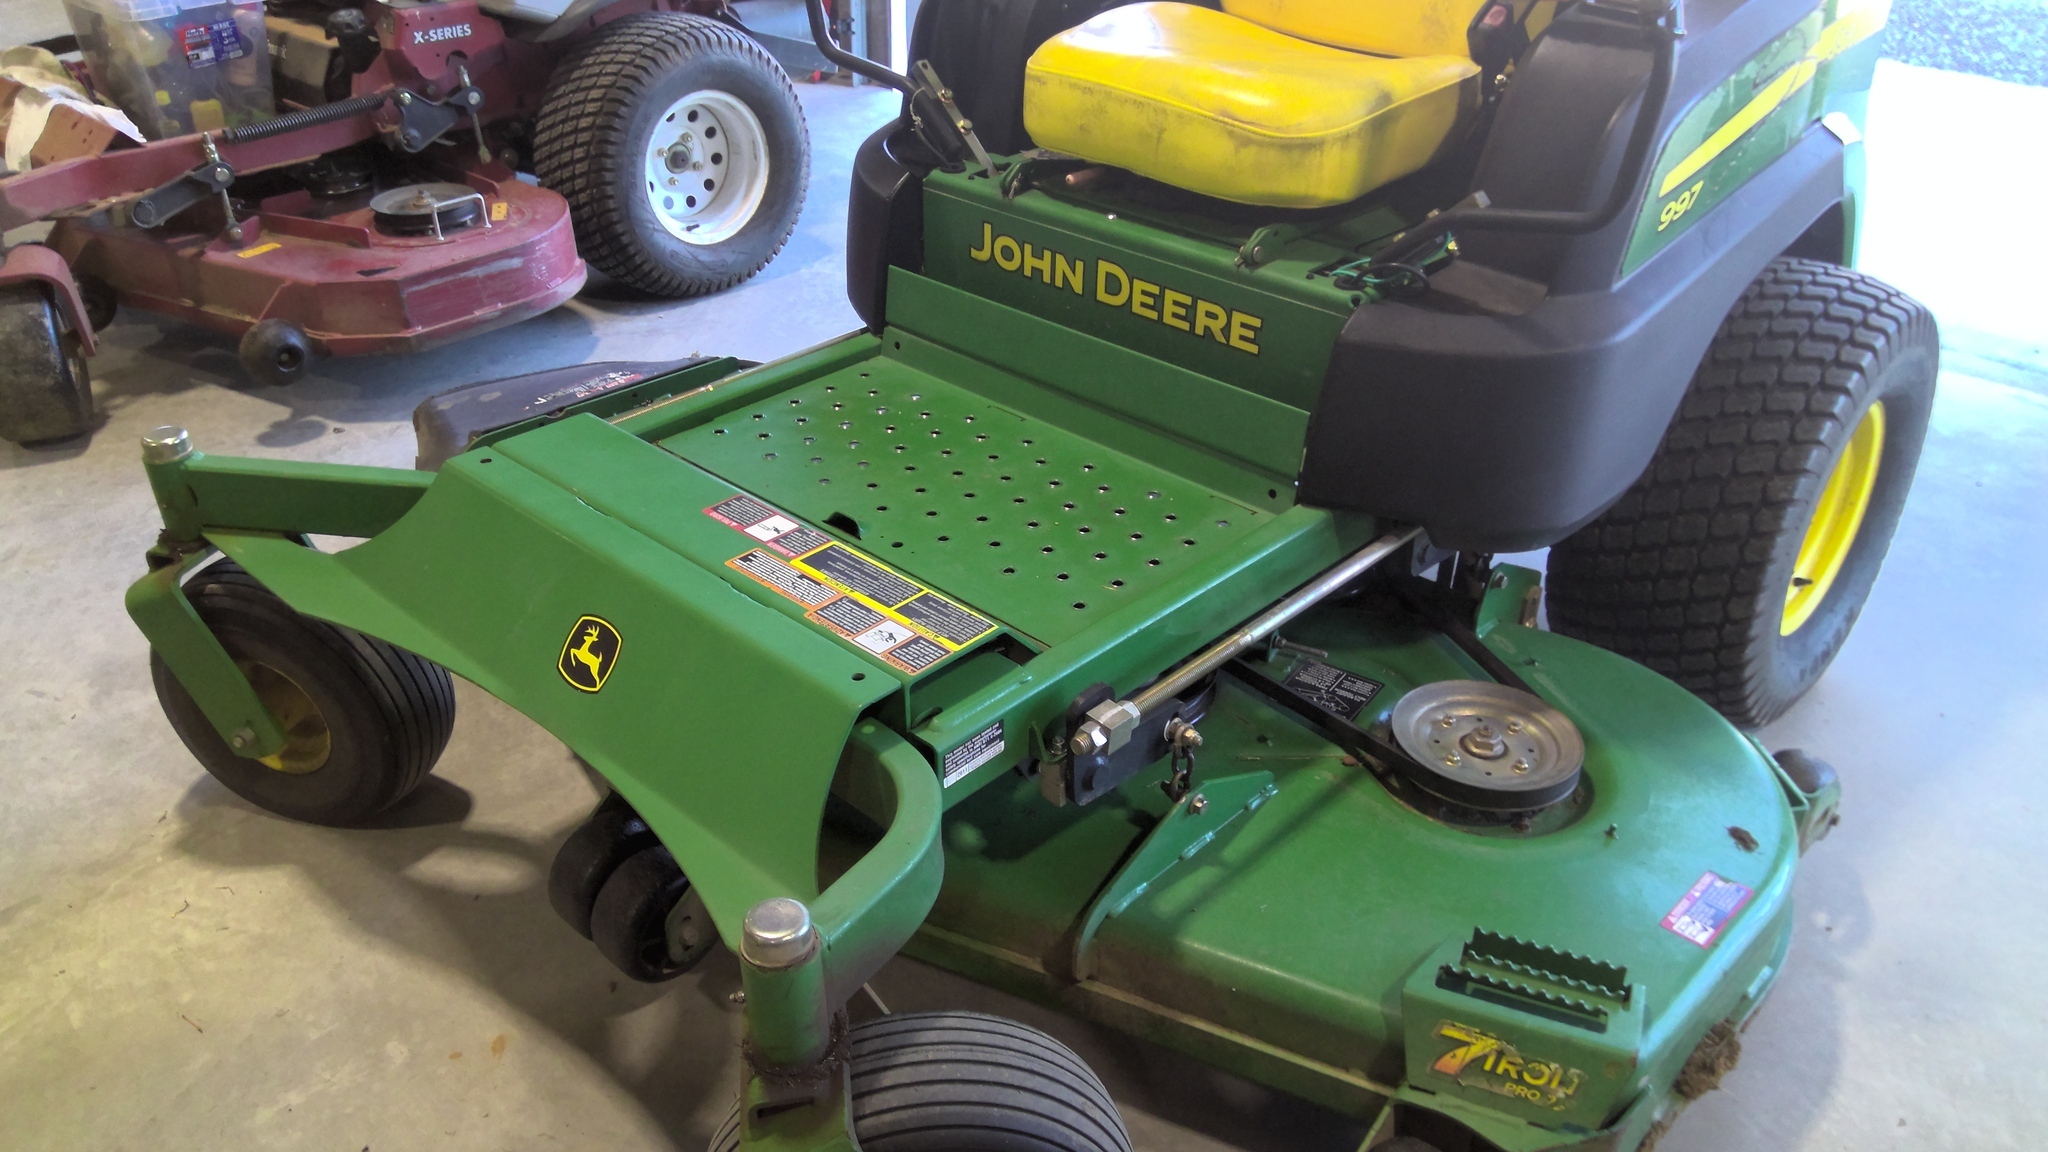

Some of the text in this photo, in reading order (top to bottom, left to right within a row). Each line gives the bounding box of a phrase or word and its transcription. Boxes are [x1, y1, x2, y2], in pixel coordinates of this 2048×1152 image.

[413, 23, 472, 44] X-SERIES
[1657, 180, 1704, 232] 997
[970, 222, 1263, 355] JOHN DEERE
[1504, 1082, 1541, 1100] PRO
